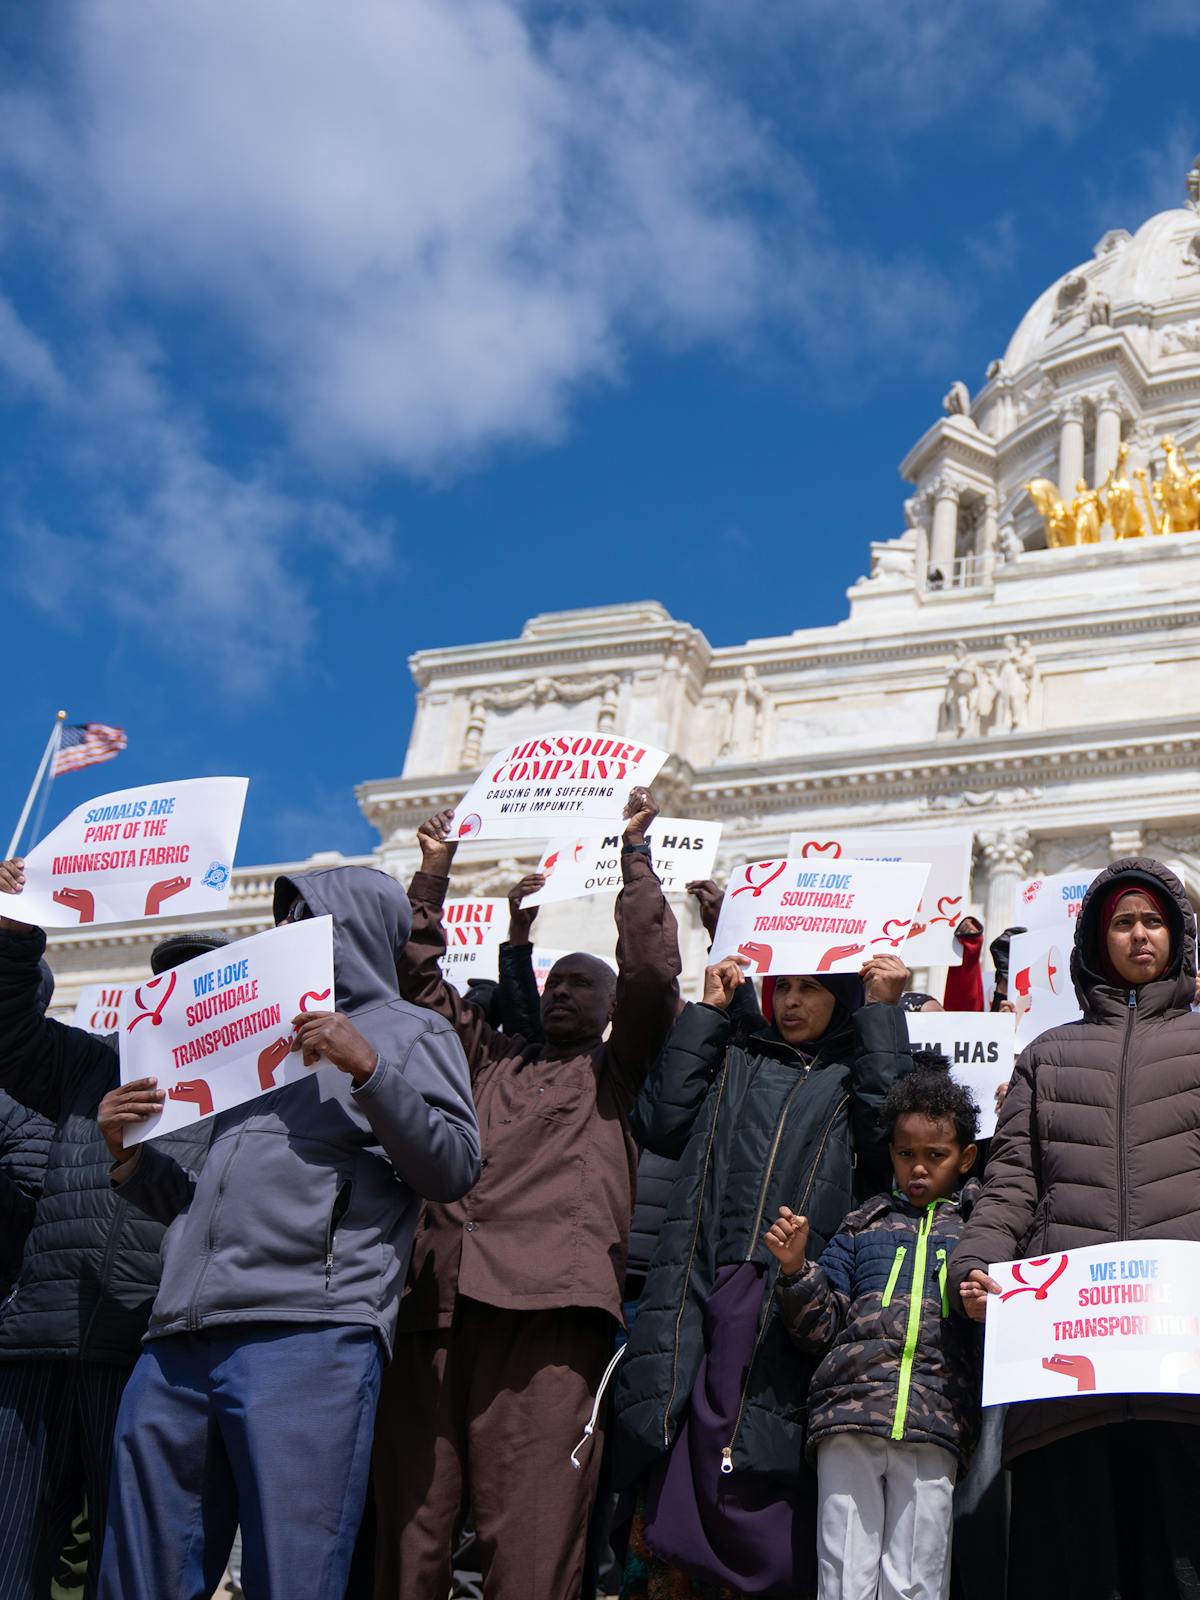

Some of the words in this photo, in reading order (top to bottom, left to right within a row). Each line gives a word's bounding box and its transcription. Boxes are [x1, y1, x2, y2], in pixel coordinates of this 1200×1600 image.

[505, 736, 648, 763] MISSOURI
[492, 759, 639, 783] COMPANY
[486, 788, 529, 799] CAUSING
[535, 787, 552, 797] MN
[555, 786, 614, 797] SUFFERING
[84, 800, 147, 824] SOMALIS
[147, 797, 176, 816] ARE
[500, 803, 527, 813] WITH
[529, 801, 584, 812] IMPUNITY.
[84, 823, 120, 843] PART
[123, 821, 140, 840] OF
[143, 818, 168, 837] THE
[662, 835, 704, 850] HAS
[52, 849, 136, 876] MINNESOTA
[139, 844, 190, 867] FABRIC
[595, 859, 617, 870] NO
[796, 872, 817, 888] WE
[819, 873, 852, 890] LOVE
[780, 891, 855, 909] SOUTHDALE
[753, 915, 867, 934] TRANSPORTATION
[193, 971, 215, 998] WE
[217, 958, 249, 988] LOVE
[185, 979, 259, 1027] SOUTHDALE
[171, 1003, 281, 1069] TRANSPORTATION
[954, 1041, 998, 1063] HAS
[1090, 1261, 1117, 1281] WE
[1120, 1259, 1159, 1280] LOVE
